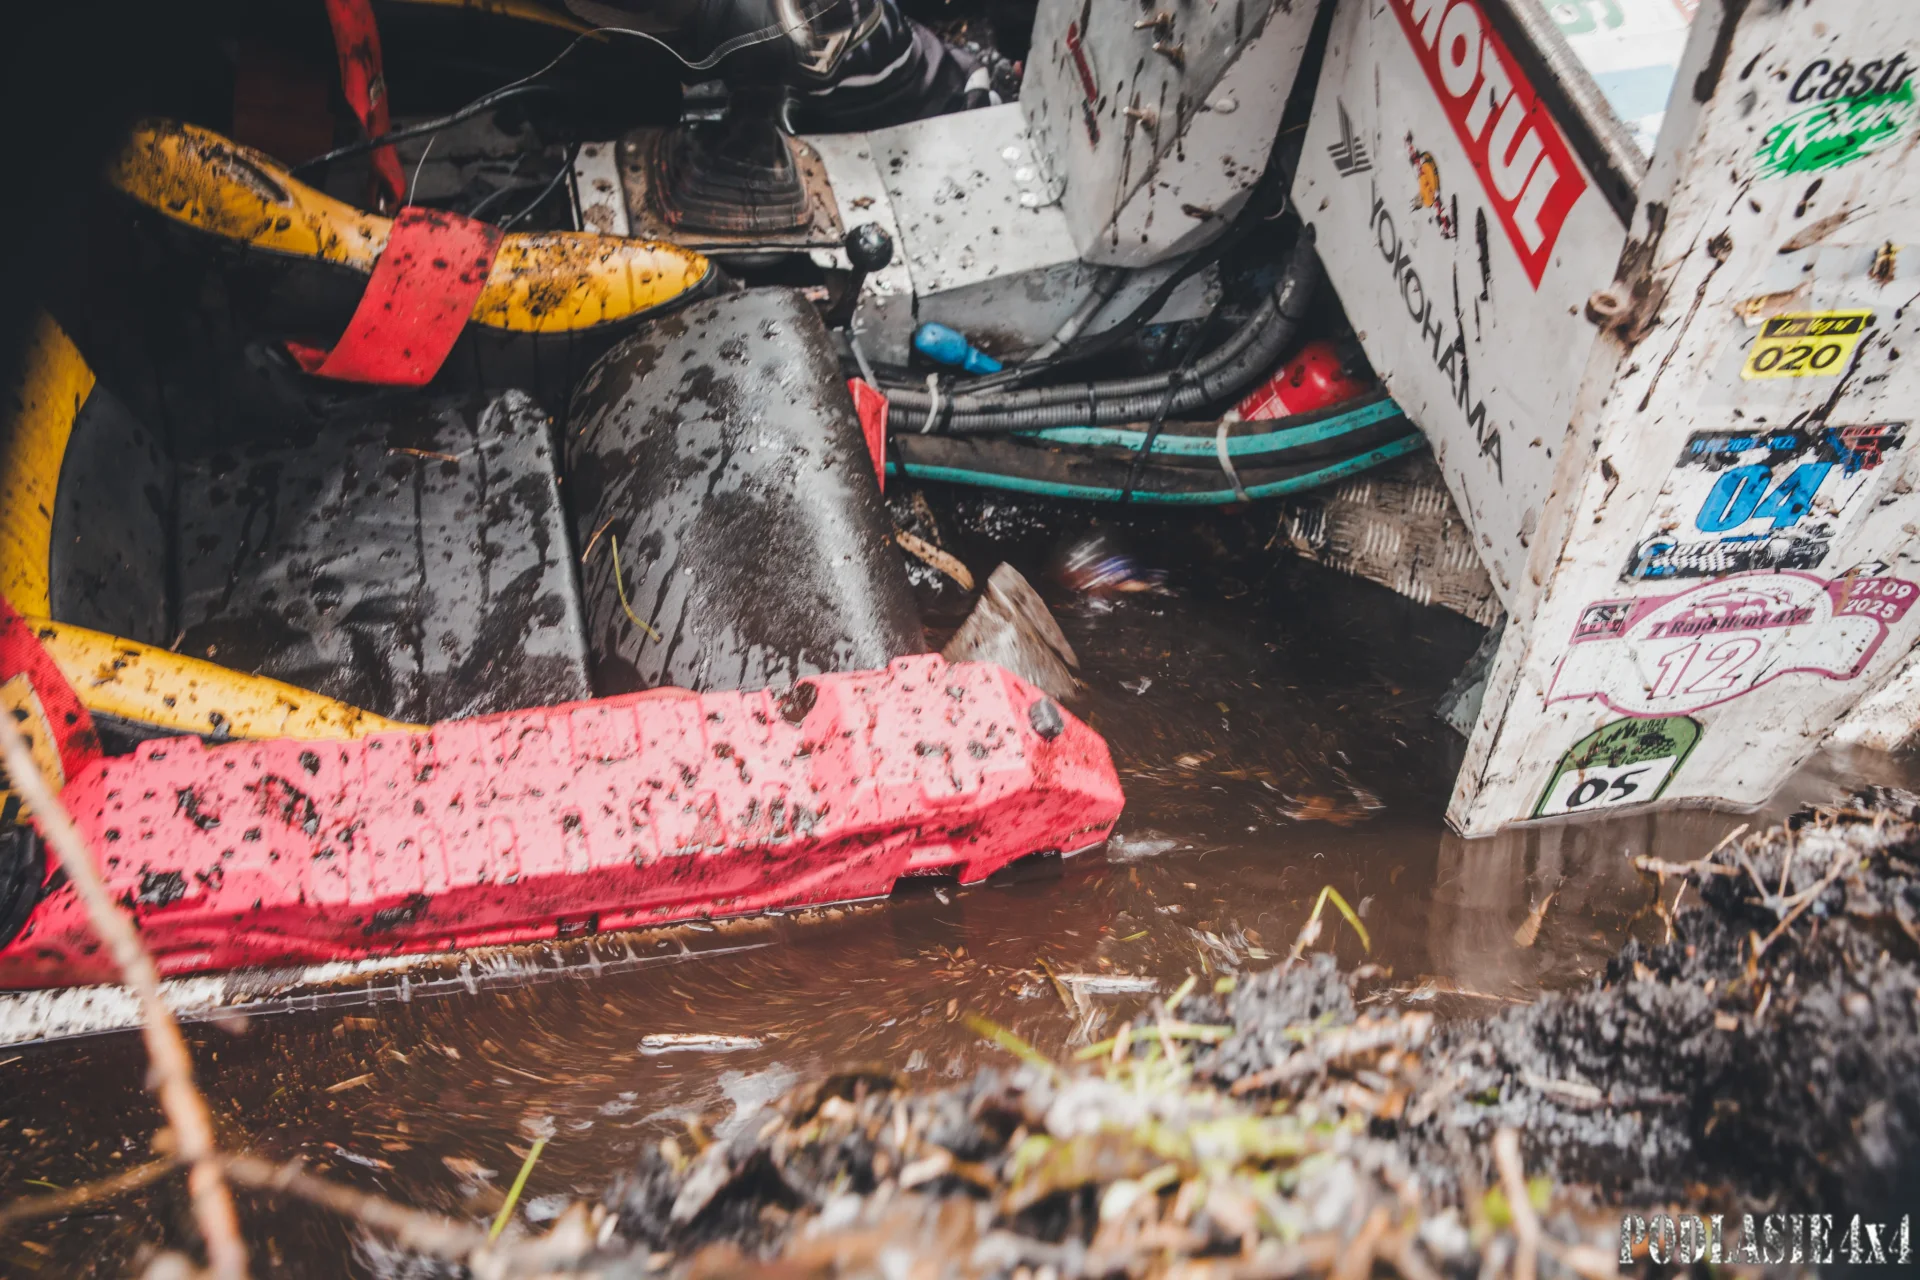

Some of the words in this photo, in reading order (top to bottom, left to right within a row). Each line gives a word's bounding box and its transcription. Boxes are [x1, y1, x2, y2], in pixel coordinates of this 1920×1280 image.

[1369, 178, 1503, 487] YOKOHAMA
[1753, 344, 1841, 372] 020
[1695, 462, 1833, 532] 04
[1843, 598, 1898, 619] 2025
[1851, 580, 1912, 599] 27.09
[1646, 637, 1761, 700] 12
[1566, 766, 1652, 807] 05
